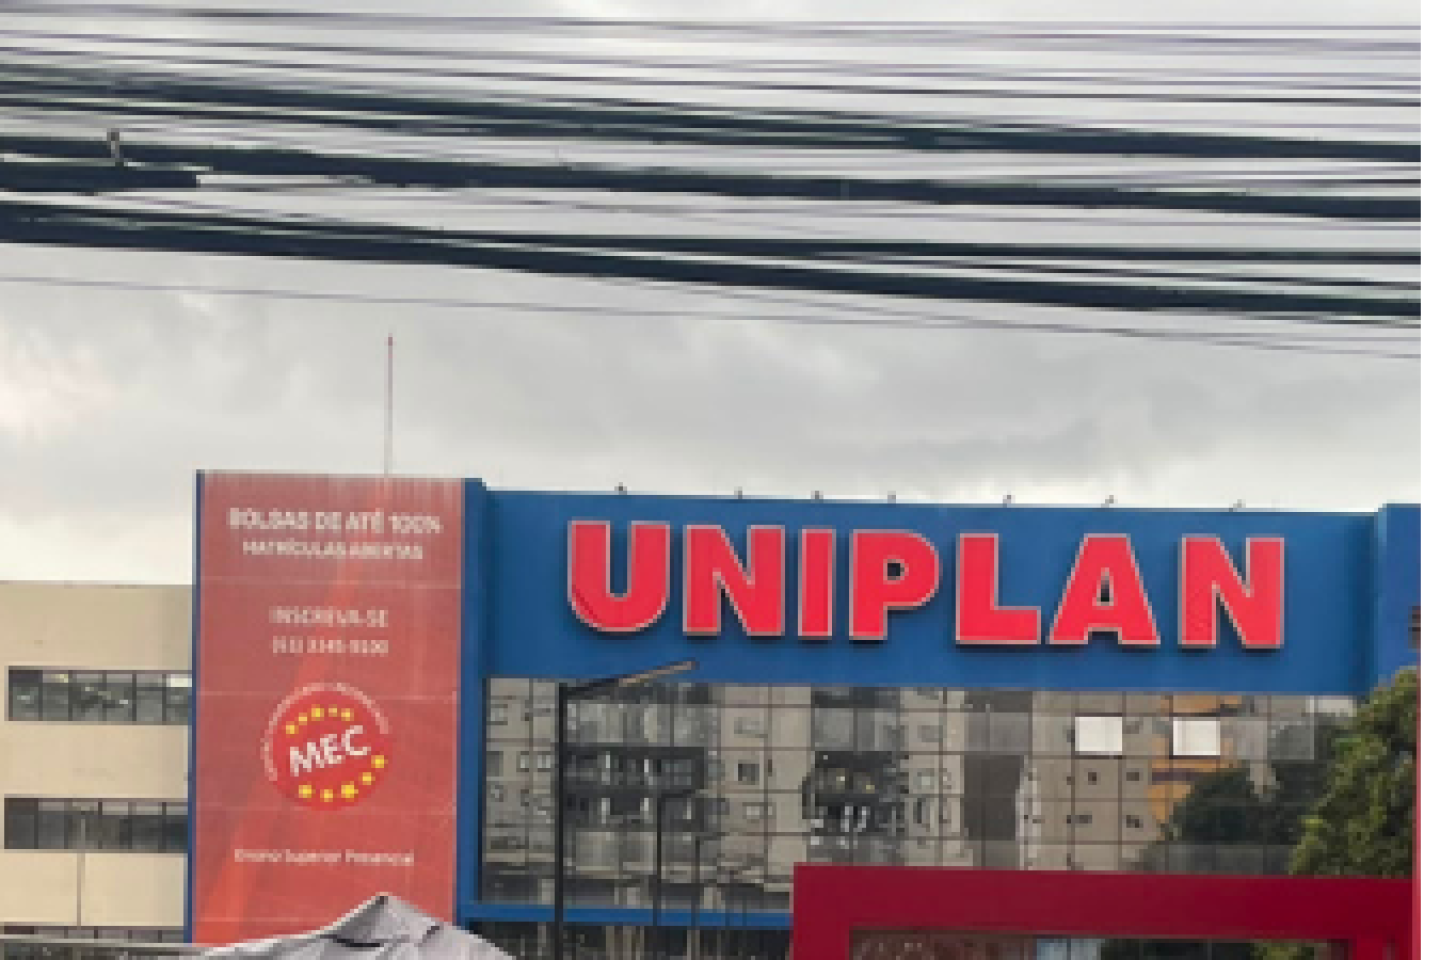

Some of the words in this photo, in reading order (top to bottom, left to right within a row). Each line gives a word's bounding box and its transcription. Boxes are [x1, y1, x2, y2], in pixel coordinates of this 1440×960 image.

[227, 507, 309, 531] BOLSAS
[315, 510, 342, 531] DE
[346, 508, 385, 533] ATÉ
[388, 513, 443, 533] 100%
[568, 520, 1286, 649] UNIPLAN
[289, 725, 371, 777] MEC
